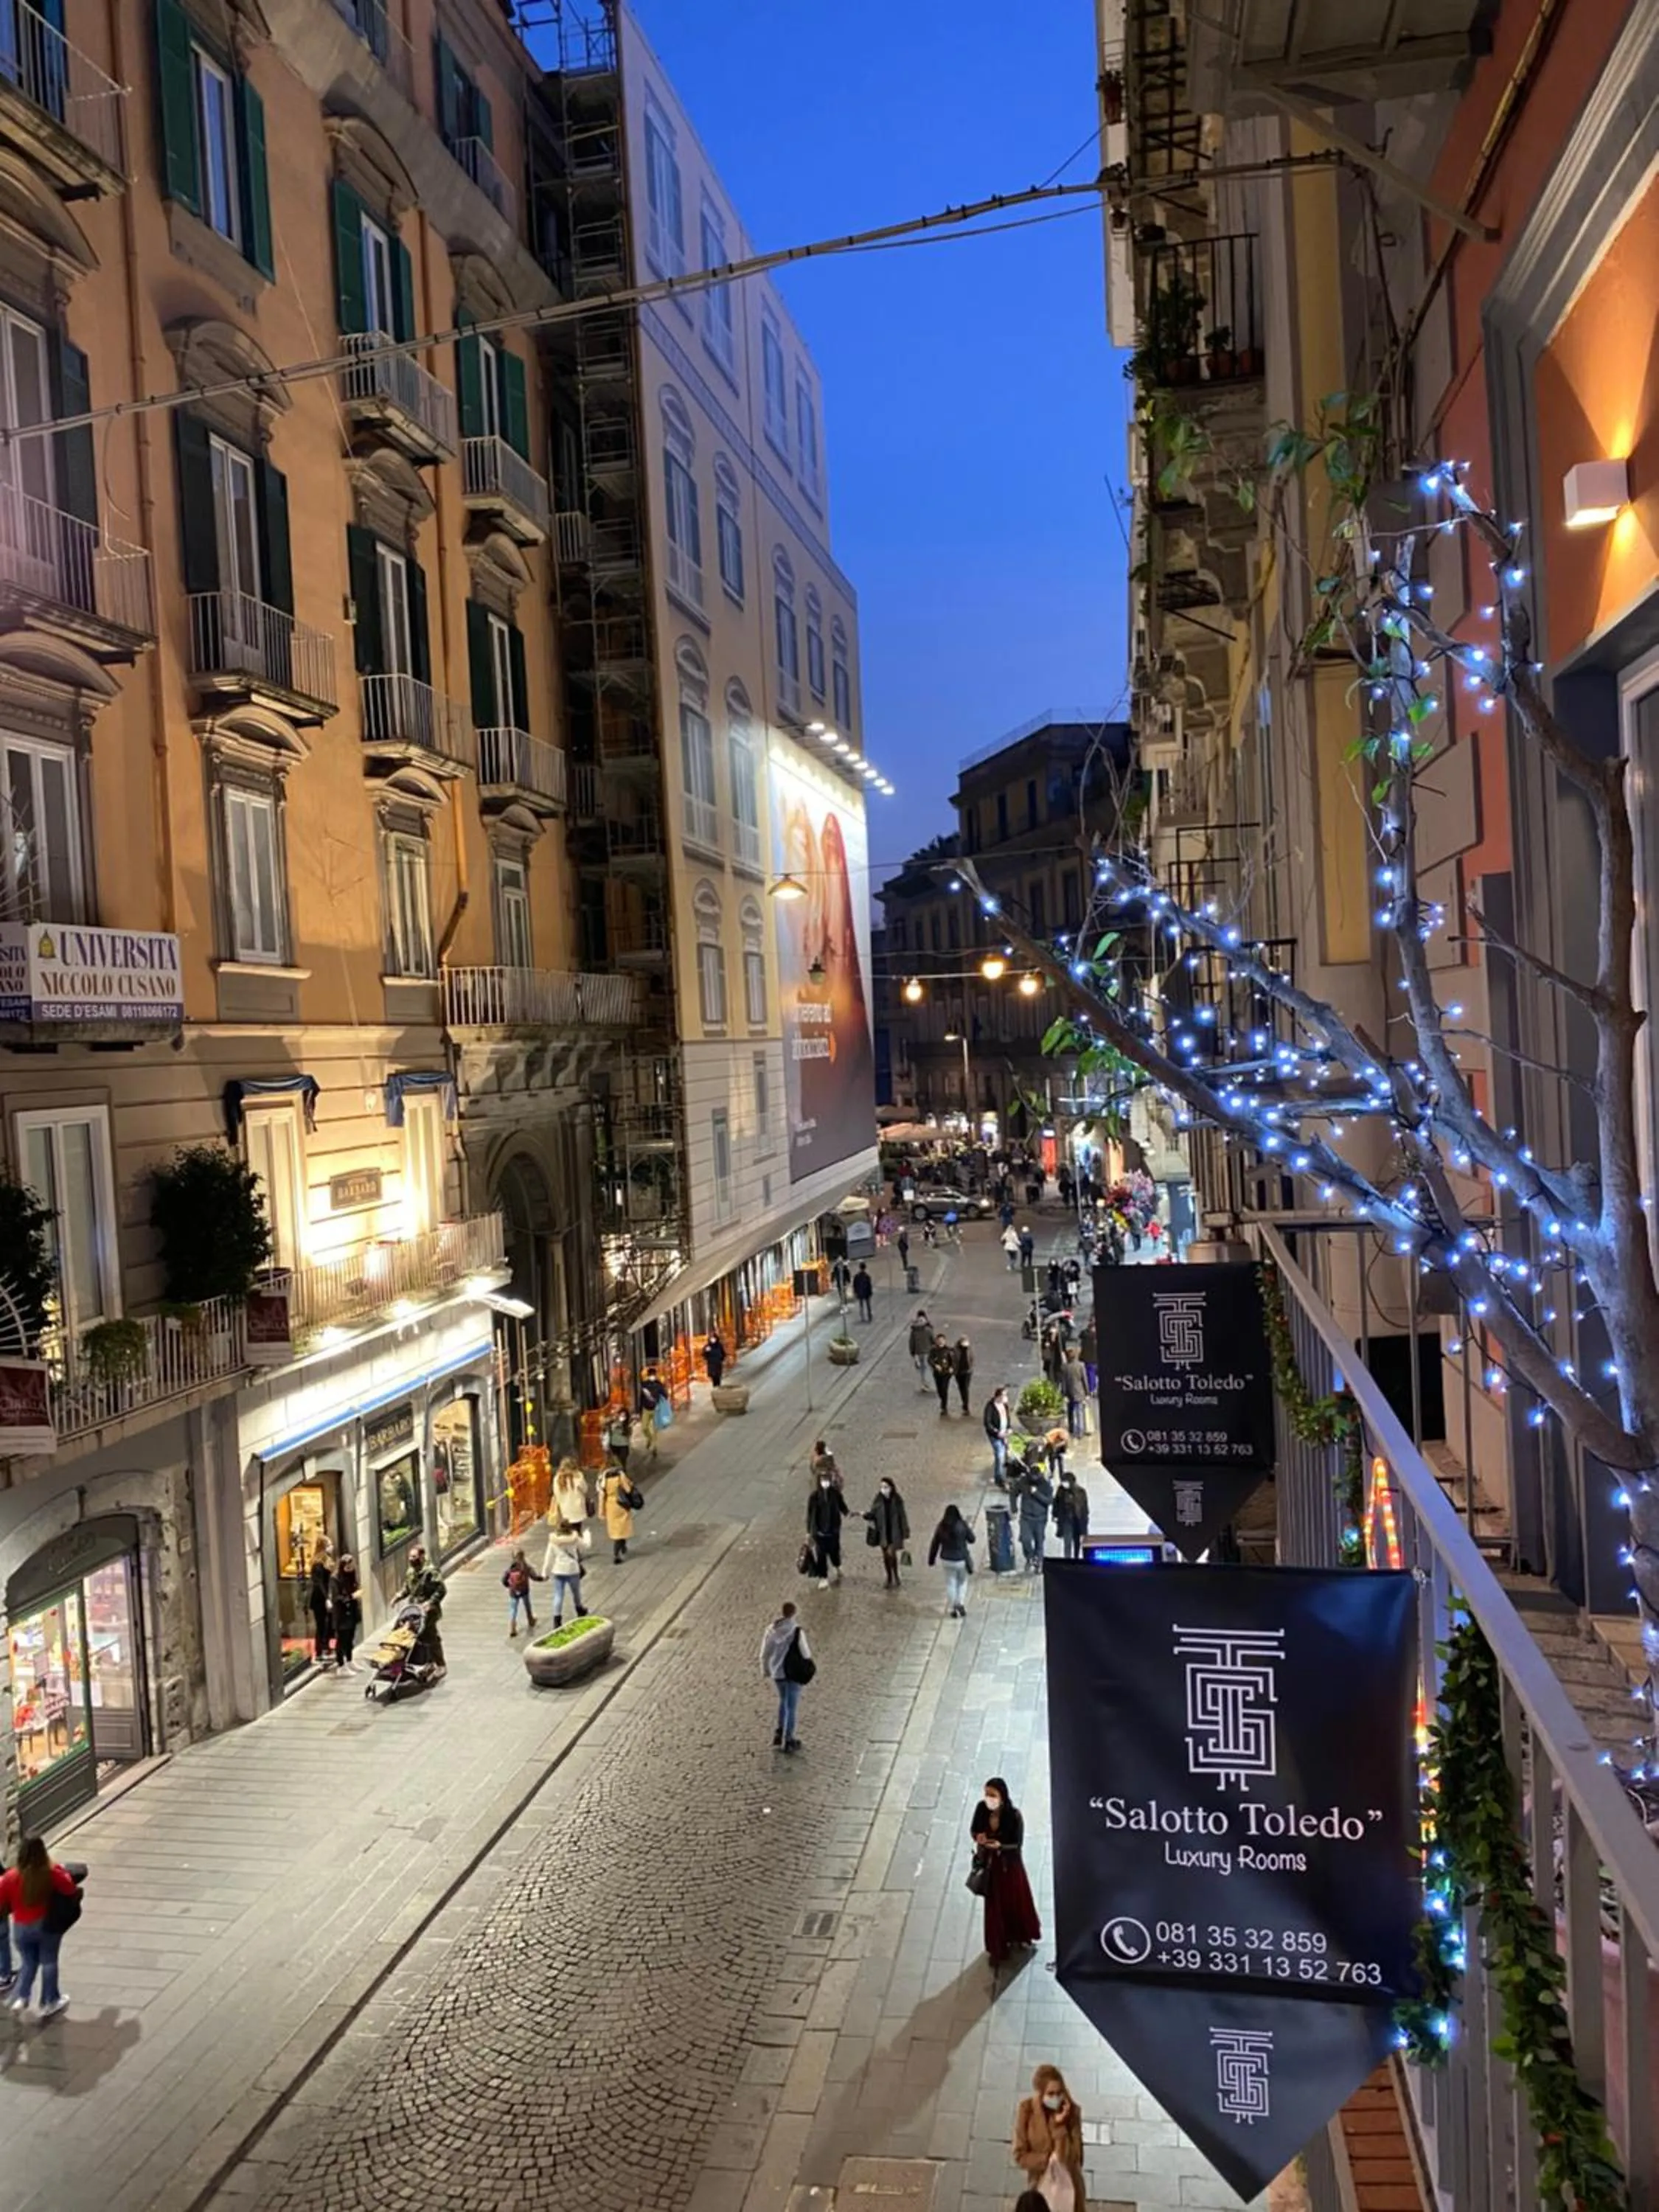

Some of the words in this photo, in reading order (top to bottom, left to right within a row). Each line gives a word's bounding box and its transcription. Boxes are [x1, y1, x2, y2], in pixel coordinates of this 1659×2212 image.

[118, 973, 176, 997] CUSANO
[41, 1004, 72, 1018] SEDE
[1150, 1393, 1183, 1408] Luxury
[1185, 1392, 1219, 1405] Rooms
[1146, 1430, 1168, 1442] 081
[1188, 1431, 1203, 1442] 32
[1172, 1444, 1193, 1455] 331
[1197, 1444, 1211, 1455] 13
[1231, 1444, 1254, 1456] 763
[1164, 1840, 1232, 1876] Luxury
[1237, 1844, 1307, 1872] Rooms
[1155, 1921, 1198, 1944] 081
[1207, 1925, 1237, 1948] 35
[1244, 1927, 1274, 1950] 32
[1281, 1930, 1327, 1954] 859
[1156, 1948, 1202, 1969] +39
[1208, 1951, 1251, 1974] 331
[1262, 1955, 1291, 1978] 13
[1298, 1958, 1328, 1981] 52
[1335, 1961, 1382, 1985] 763
